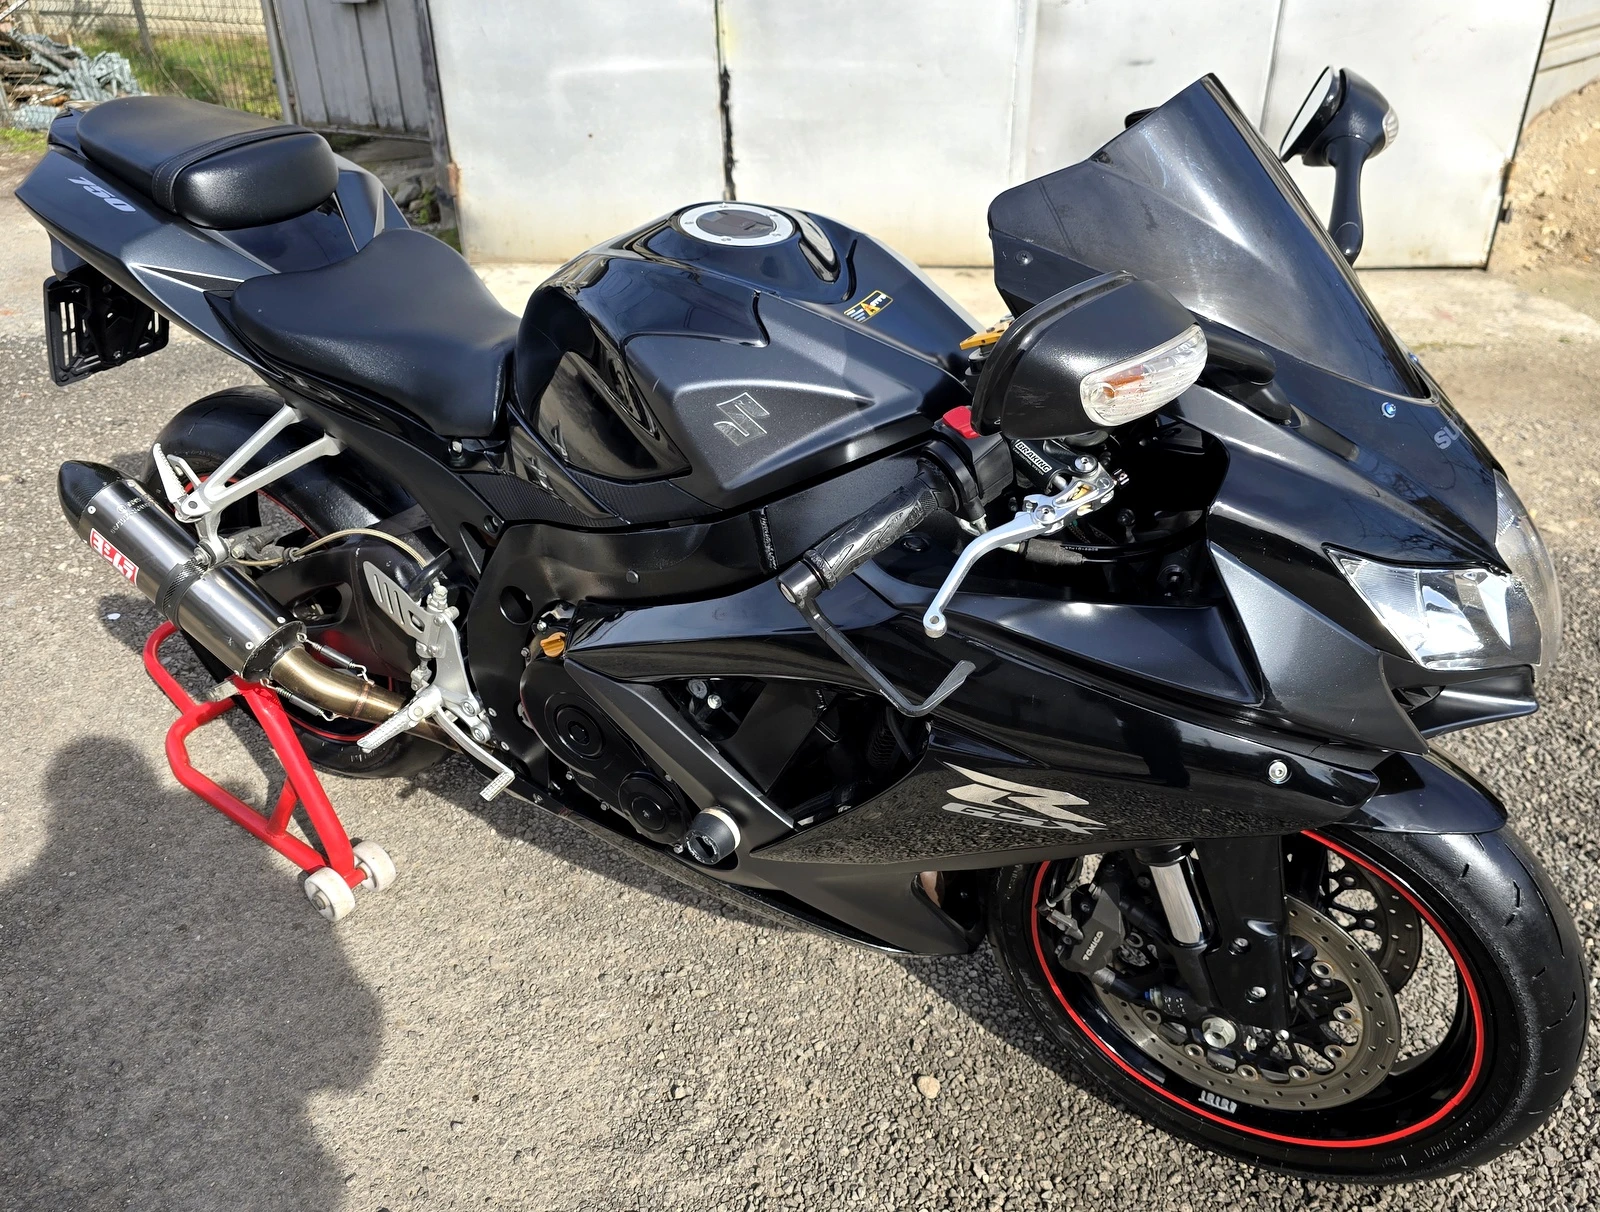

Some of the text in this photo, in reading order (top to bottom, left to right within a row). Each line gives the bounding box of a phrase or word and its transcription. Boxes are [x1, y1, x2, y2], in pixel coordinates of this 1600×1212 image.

[67, 176, 136, 212] 750
[1016, 442, 1051, 472] BRAKING
[1083, 931, 1104, 961] TOKICO
